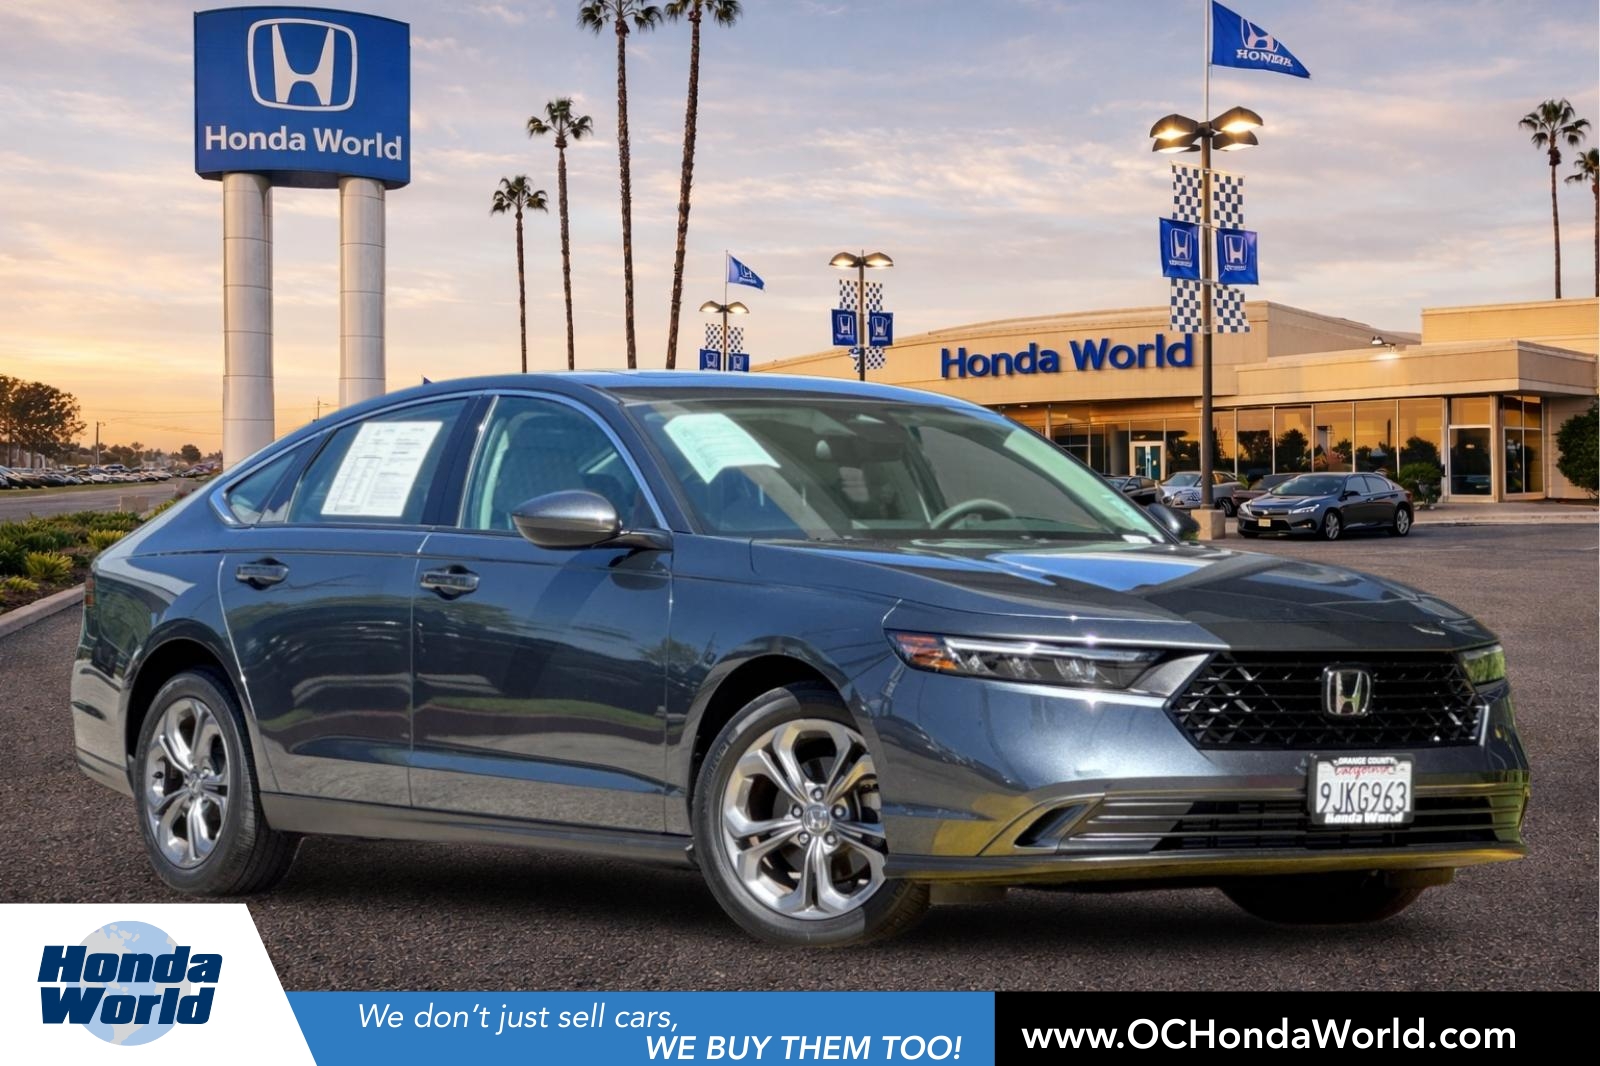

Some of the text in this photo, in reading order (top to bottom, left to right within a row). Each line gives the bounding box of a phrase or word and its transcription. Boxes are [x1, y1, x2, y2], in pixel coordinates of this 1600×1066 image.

[205, 125, 402, 160] Honda World
[941, 333, 1194, 378] Honda World
[1320, 782, 1407, 813] 9JKG963
